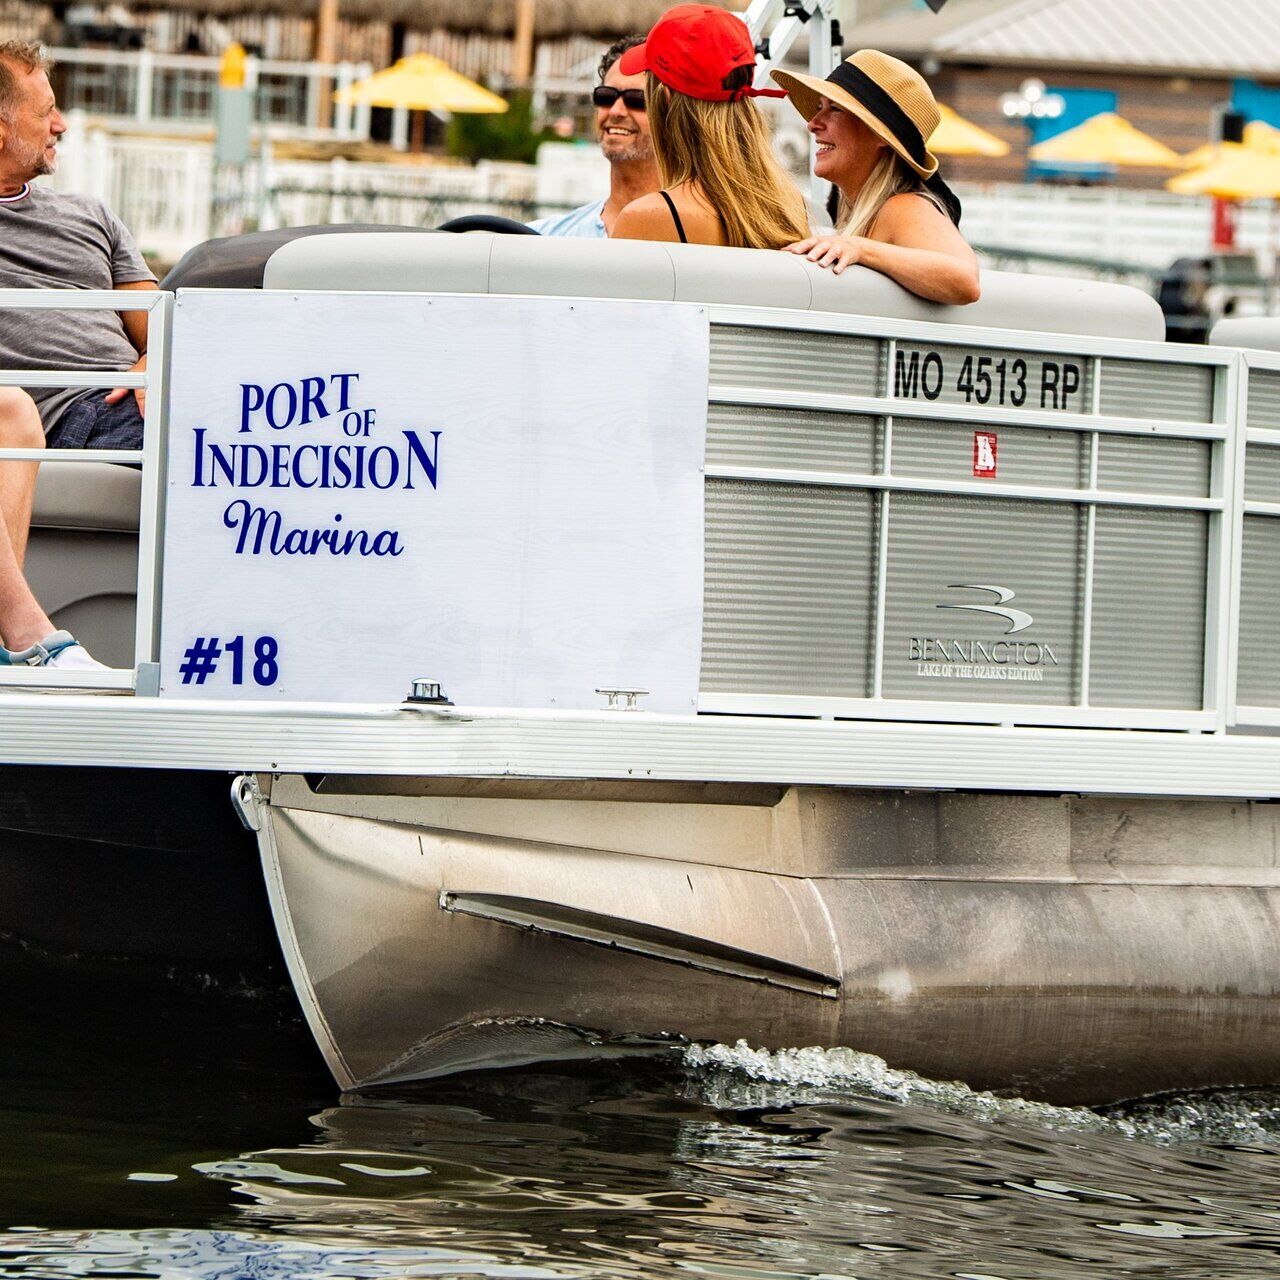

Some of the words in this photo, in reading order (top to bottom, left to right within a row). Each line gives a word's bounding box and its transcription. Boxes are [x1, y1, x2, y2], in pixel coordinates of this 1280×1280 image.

[238, 373, 359, 433] PORT
[342, 409, 377, 437] OF
[894, 350, 944, 401] MO
[957, 355, 1027, 407] 4513
[1040, 361, 1080, 410] RP
[191, 428, 442, 490] INDECISION
[223, 499, 404, 557] Marina
[178, 635, 278, 686] #18
[908, 637, 1059, 666] BENNINGTON
[917, 663, 940, 677] LAKE
[941, 664, 953, 677] OF
[954, 665, 973, 678] THE
[973, 665, 1007, 680] OZARKS
[1007, 667, 1044, 681] EDITION
